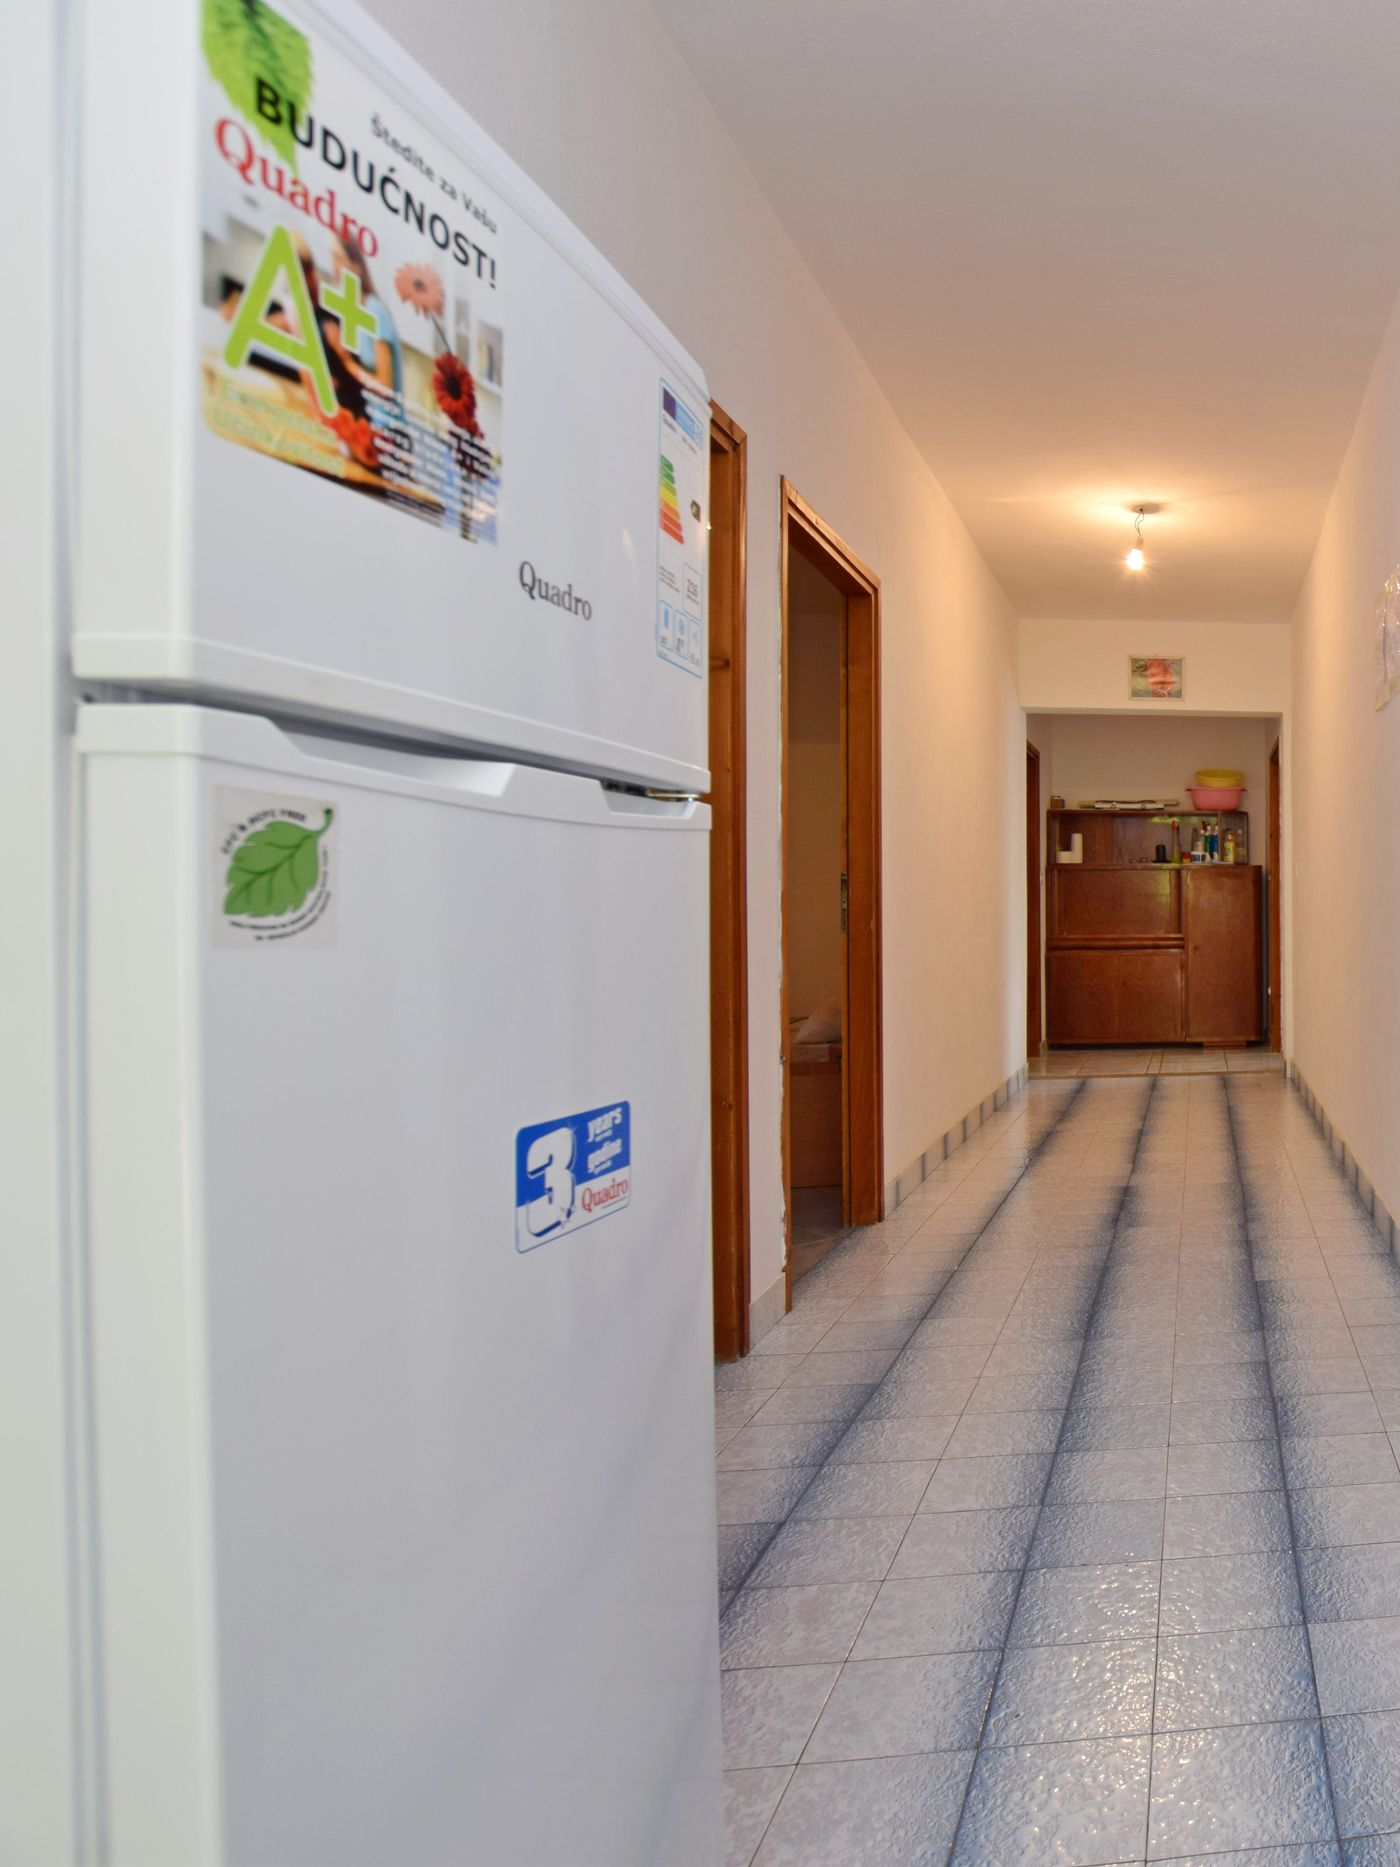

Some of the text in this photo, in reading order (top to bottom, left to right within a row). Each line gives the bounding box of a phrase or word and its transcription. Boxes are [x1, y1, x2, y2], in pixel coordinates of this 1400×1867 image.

[214, 117, 378, 258] Quadro
[256, 76, 497, 289] BUDUĆNOST!
[223, 225, 378, 416] A+
[519, 560, 593, 622] Quadro
[526, 1126, 577, 1238] 3
[580, 1177, 629, 1213] Quadro
